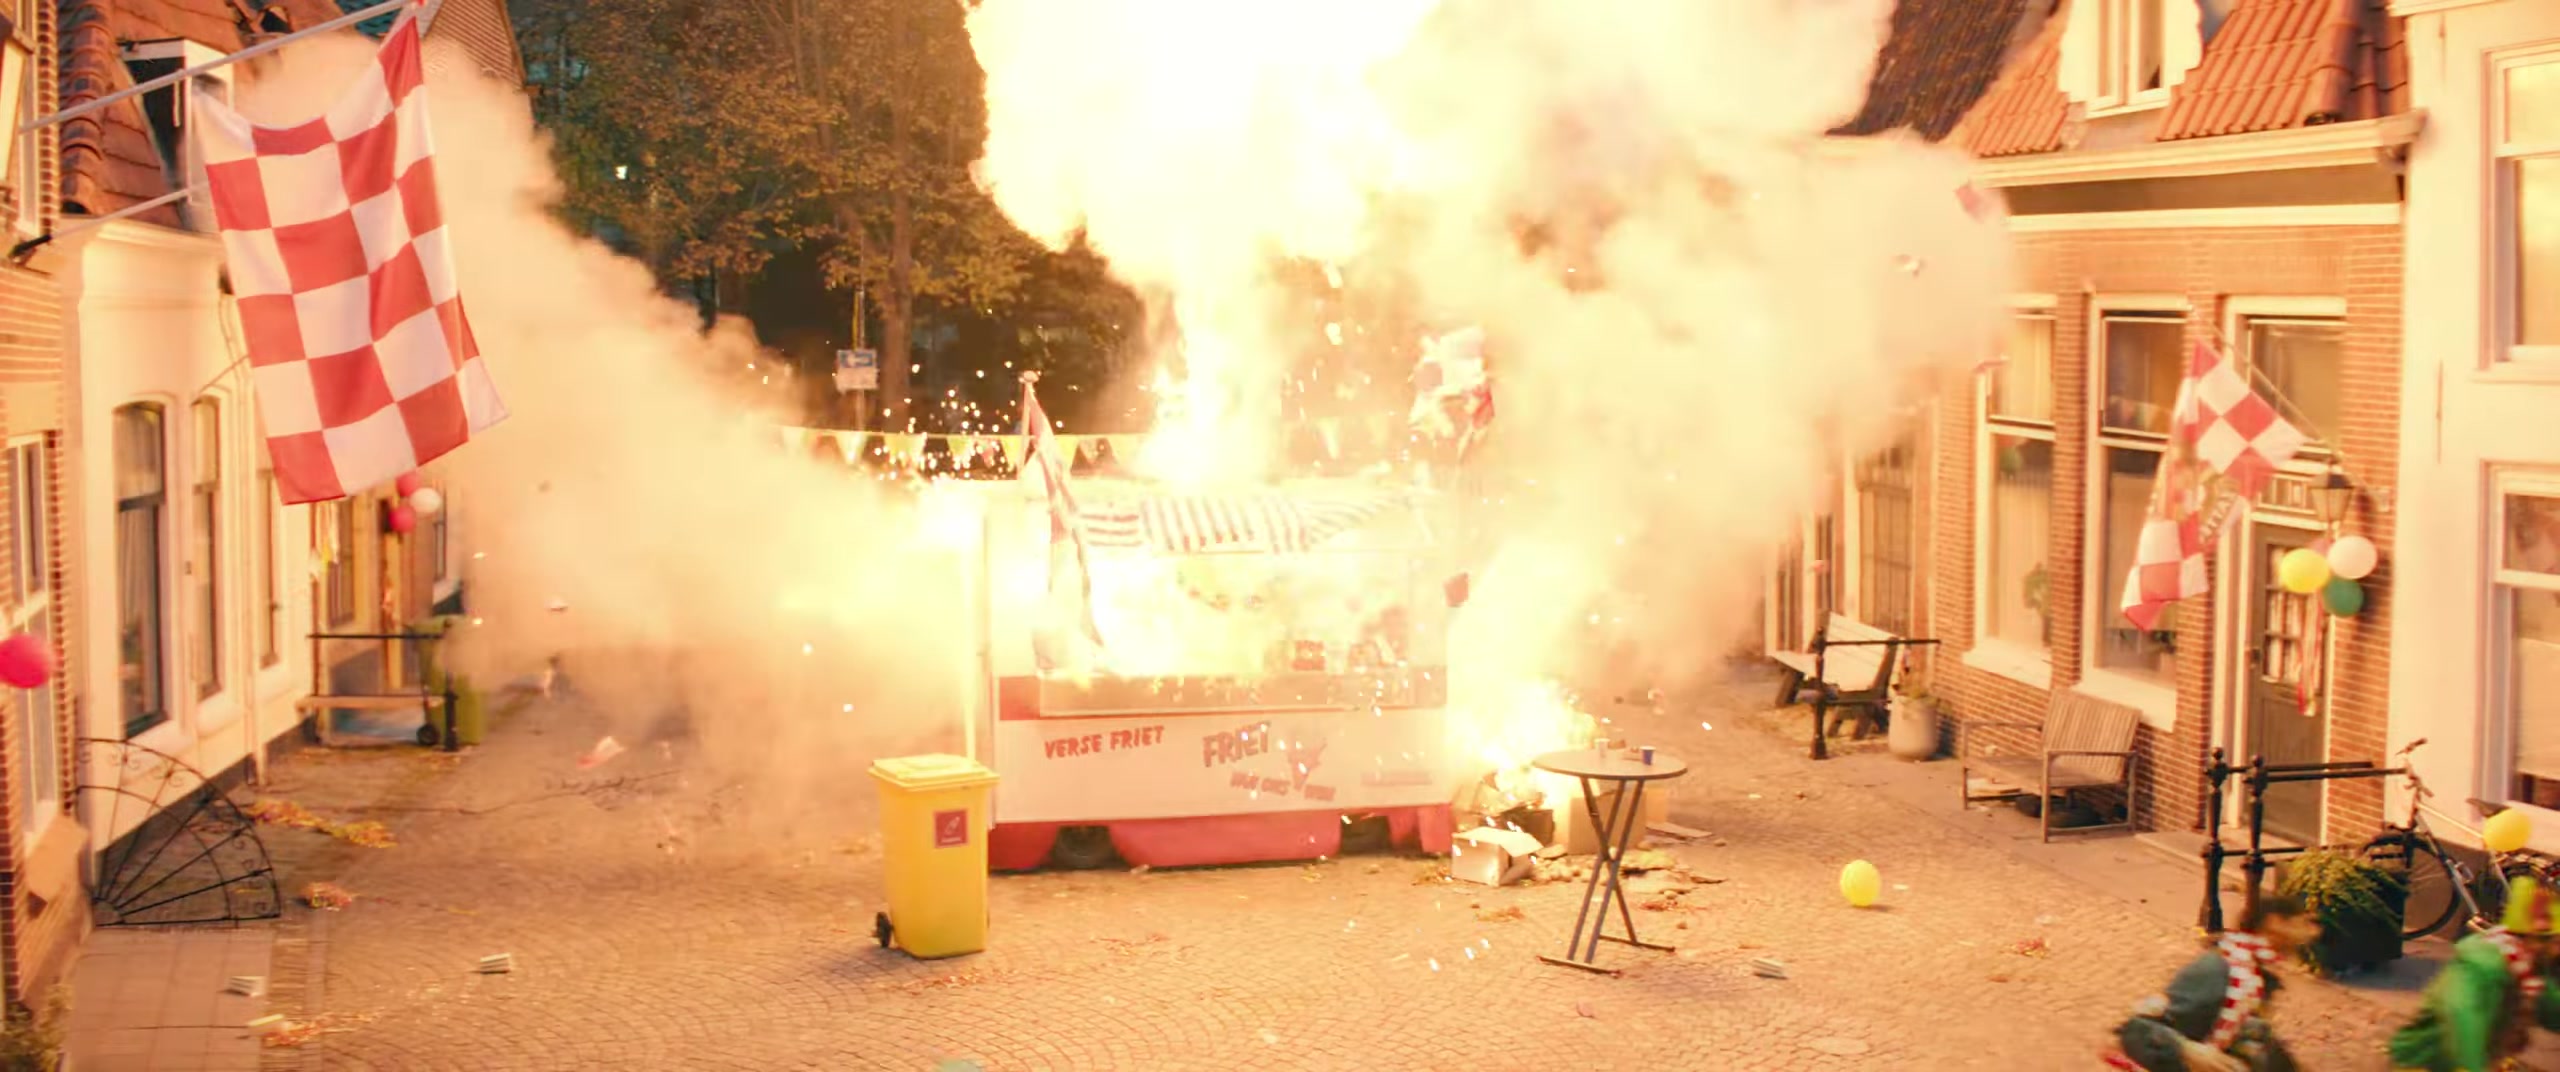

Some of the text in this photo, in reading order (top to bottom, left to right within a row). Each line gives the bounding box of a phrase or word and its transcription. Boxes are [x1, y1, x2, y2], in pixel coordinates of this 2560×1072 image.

[1044, 724, 1165, 760] VERSE FRIET
[1202, 720, 1271, 768] FRIET
